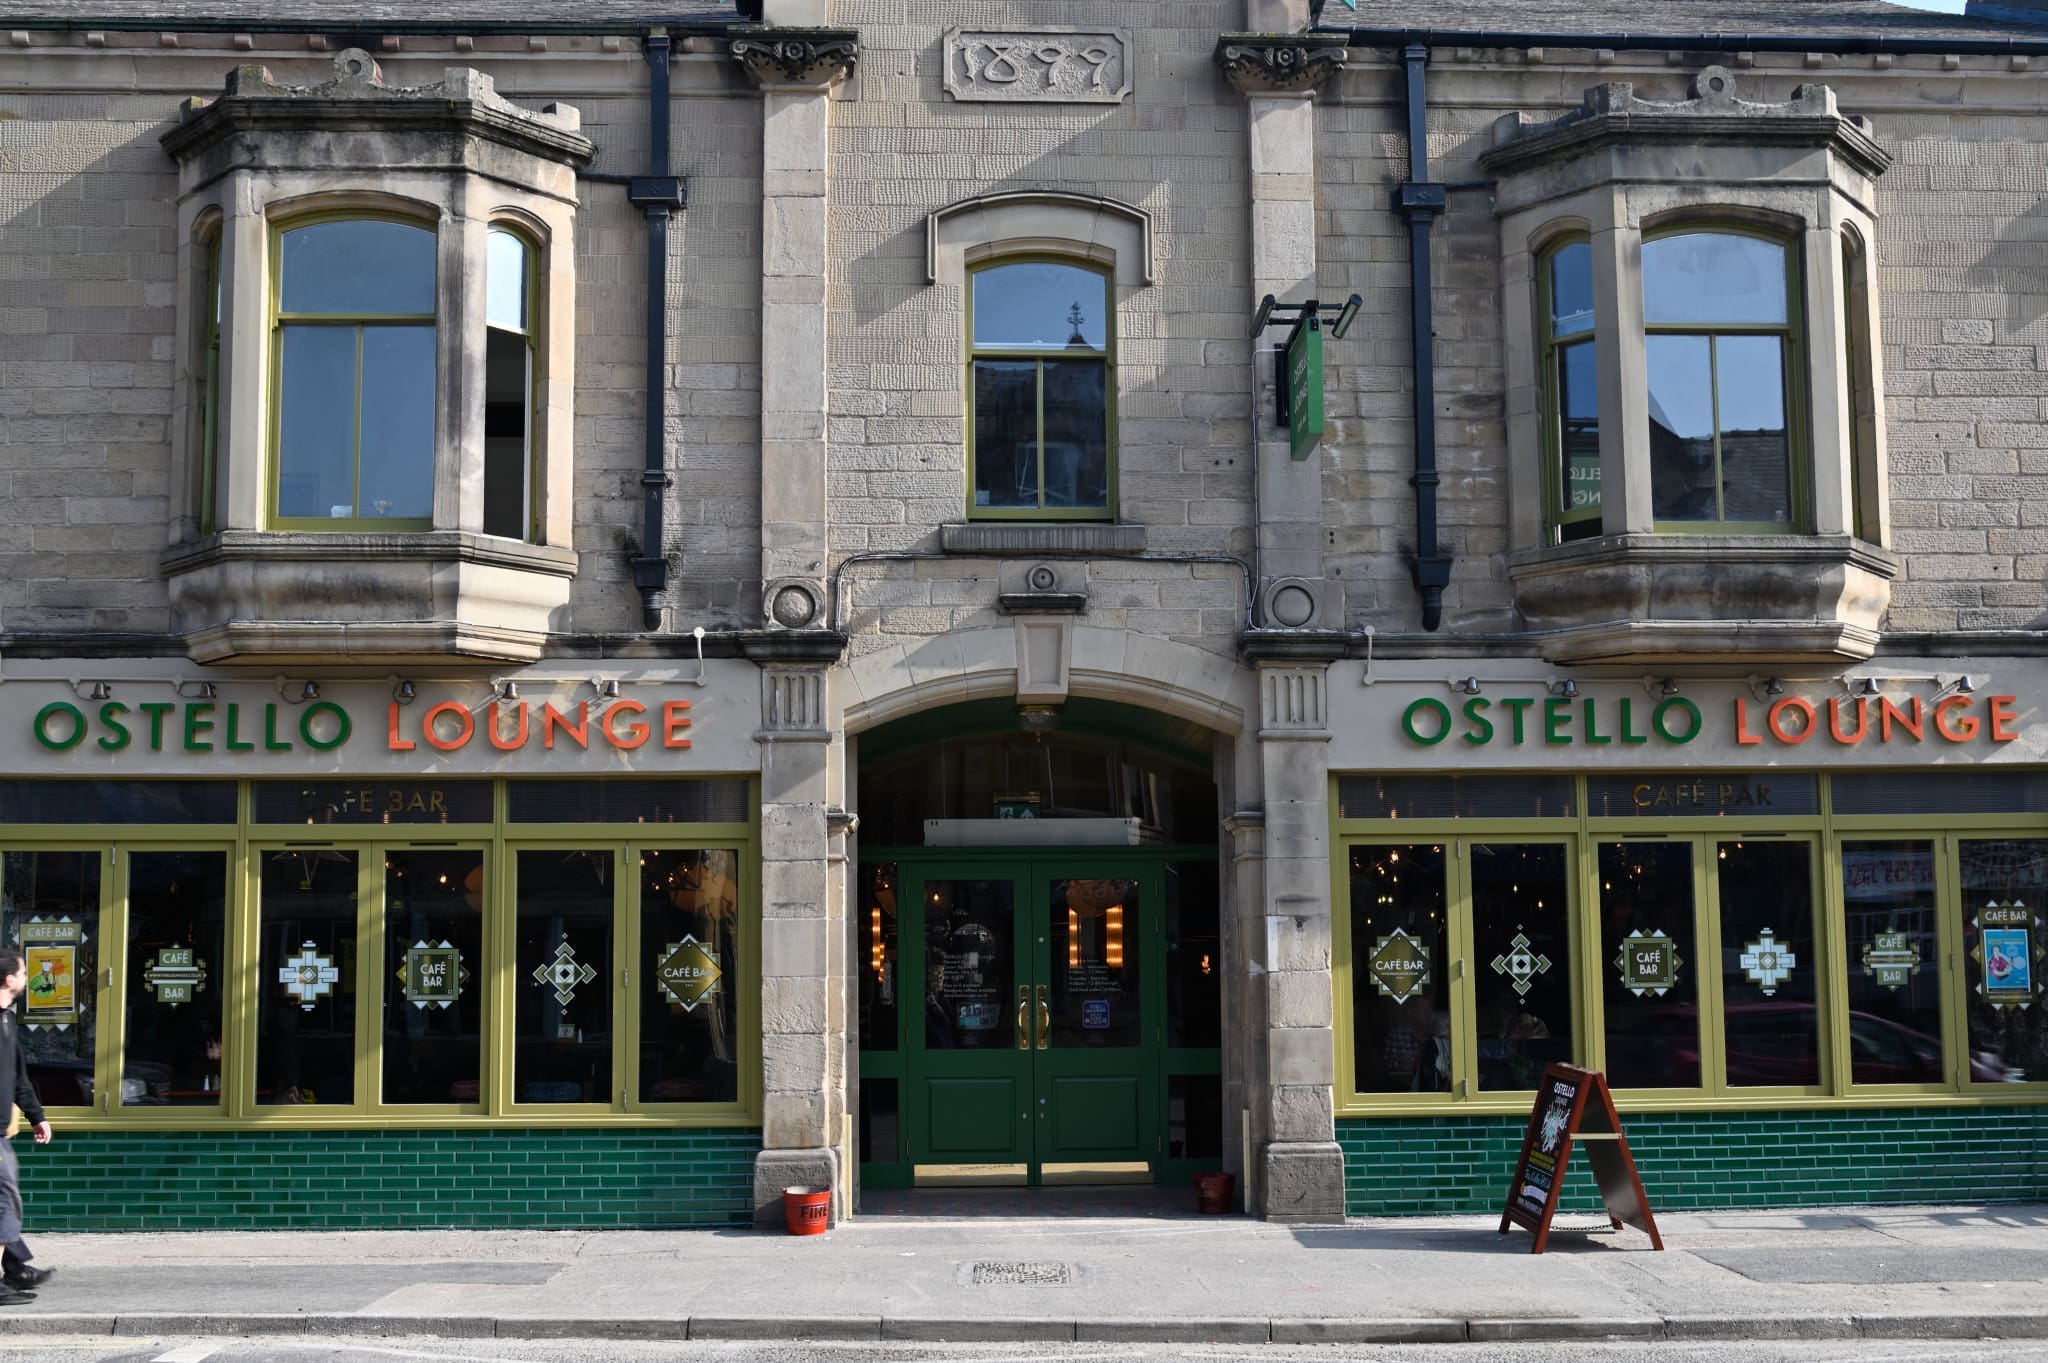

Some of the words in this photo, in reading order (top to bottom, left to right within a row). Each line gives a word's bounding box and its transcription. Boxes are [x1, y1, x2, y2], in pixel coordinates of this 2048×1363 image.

[33, 702, 352, 751] OSTELLO
[388, 700, 693, 751] LOUNGE
[1402, 697, 1702, 745] OSTELLO
[1737, 695, 2018, 744] LOUNGE
[1632, 779, 1705, 807] CAFÉ
[1719, 783, 1773, 806] BAR
[1984, 909, 2008, 921] CAFÉ
[2010, 910, 2027, 921] BAR
[27, 924, 52, 937] CAFÉ
[55, 927, 74, 937] BAR
[1879, 935, 1902, 948] CAFÉ
[163, 951, 188, 964] CAFÉ
[1636, 950, 1661, 963] CAFÉ
[420, 961, 446, 975] CAFÉ
[1375, 958, 1401, 970] CAFÉ
[1403, 960, 1424, 970] BAR
[1639, 964, 1658, 975] BAR
[664, 965, 690, 978] CAFÉ
[1883, 970, 1901, 981] BAR
[423, 976, 443, 987] BAR
[165, 987, 184, 999] BAR
